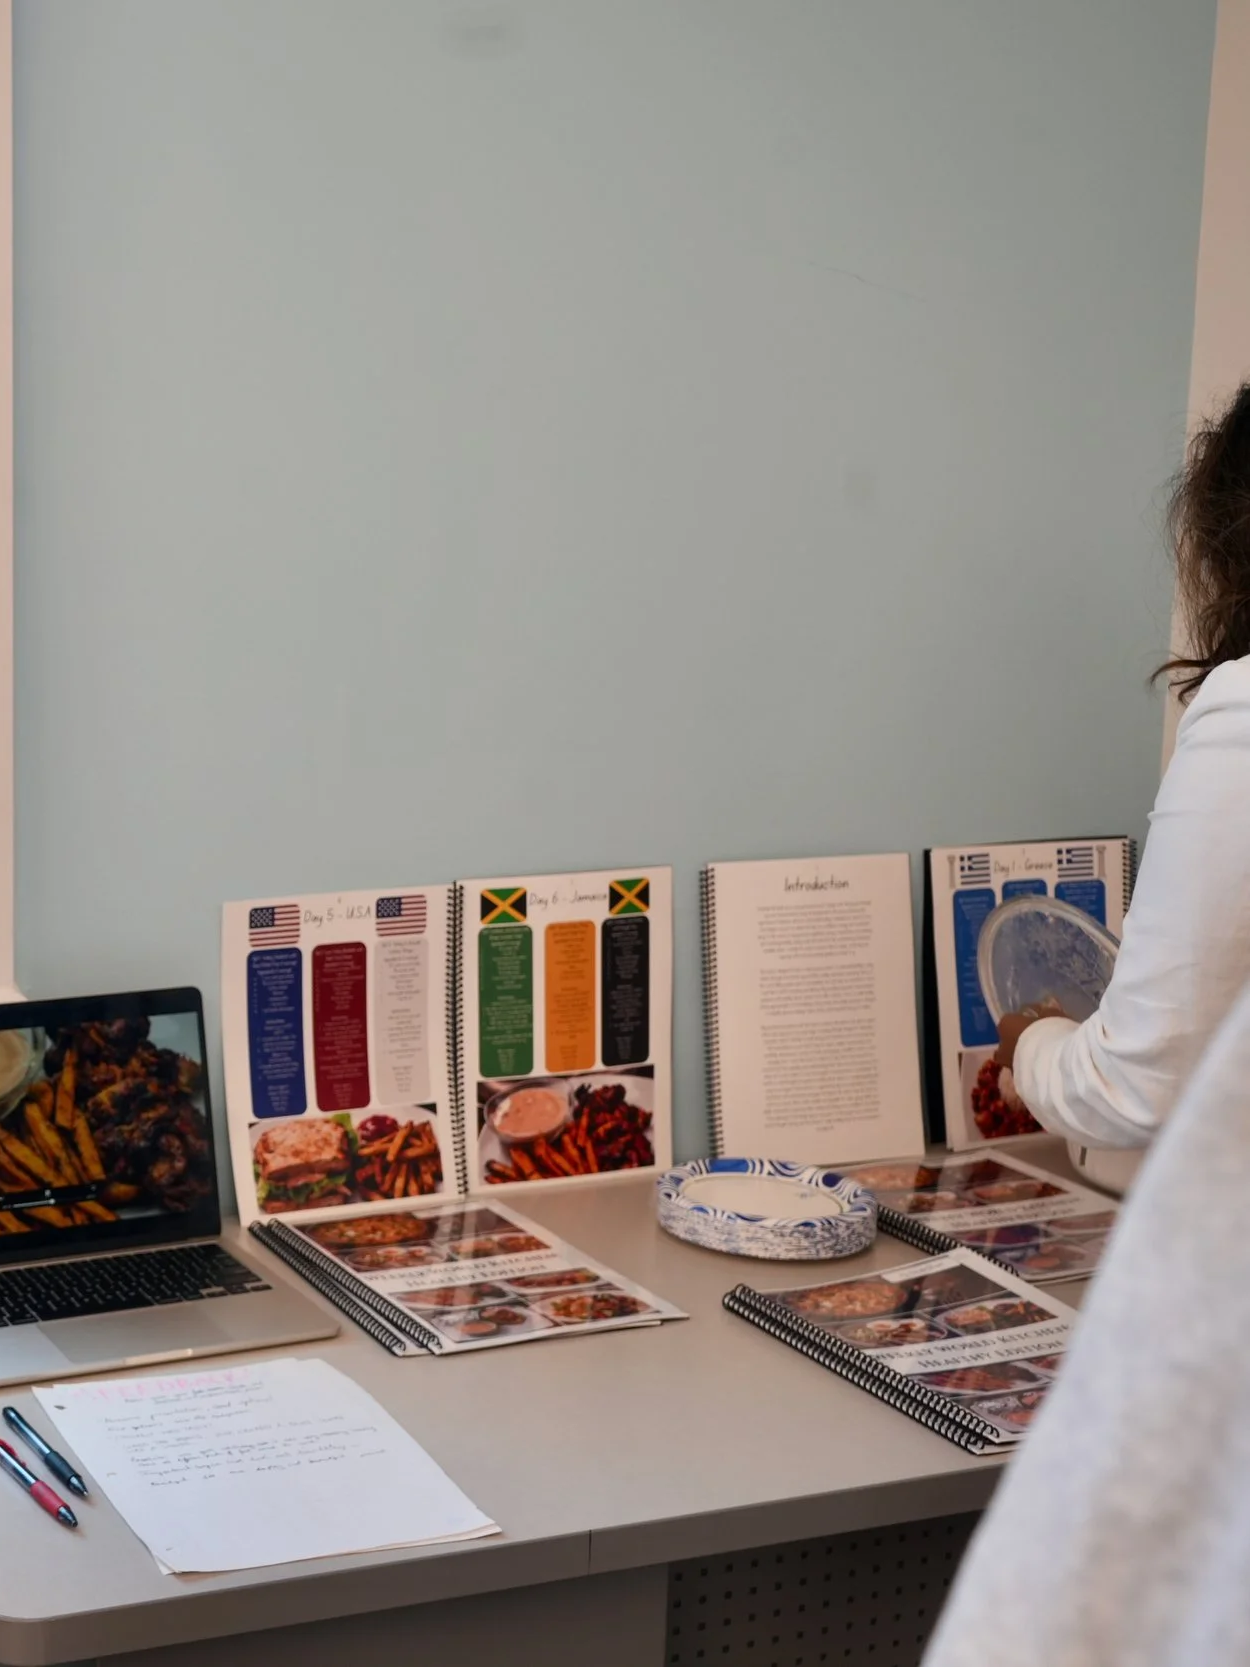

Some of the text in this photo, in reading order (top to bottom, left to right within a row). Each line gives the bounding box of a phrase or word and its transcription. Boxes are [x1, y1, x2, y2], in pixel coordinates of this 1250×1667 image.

[784, 874, 849, 892] Introduction
[529, 892, 548, 911] Day
[303, 909, 324, 928] Day
[326, 907, 334, 922] 5
[346, 904, 371, 919] USA
